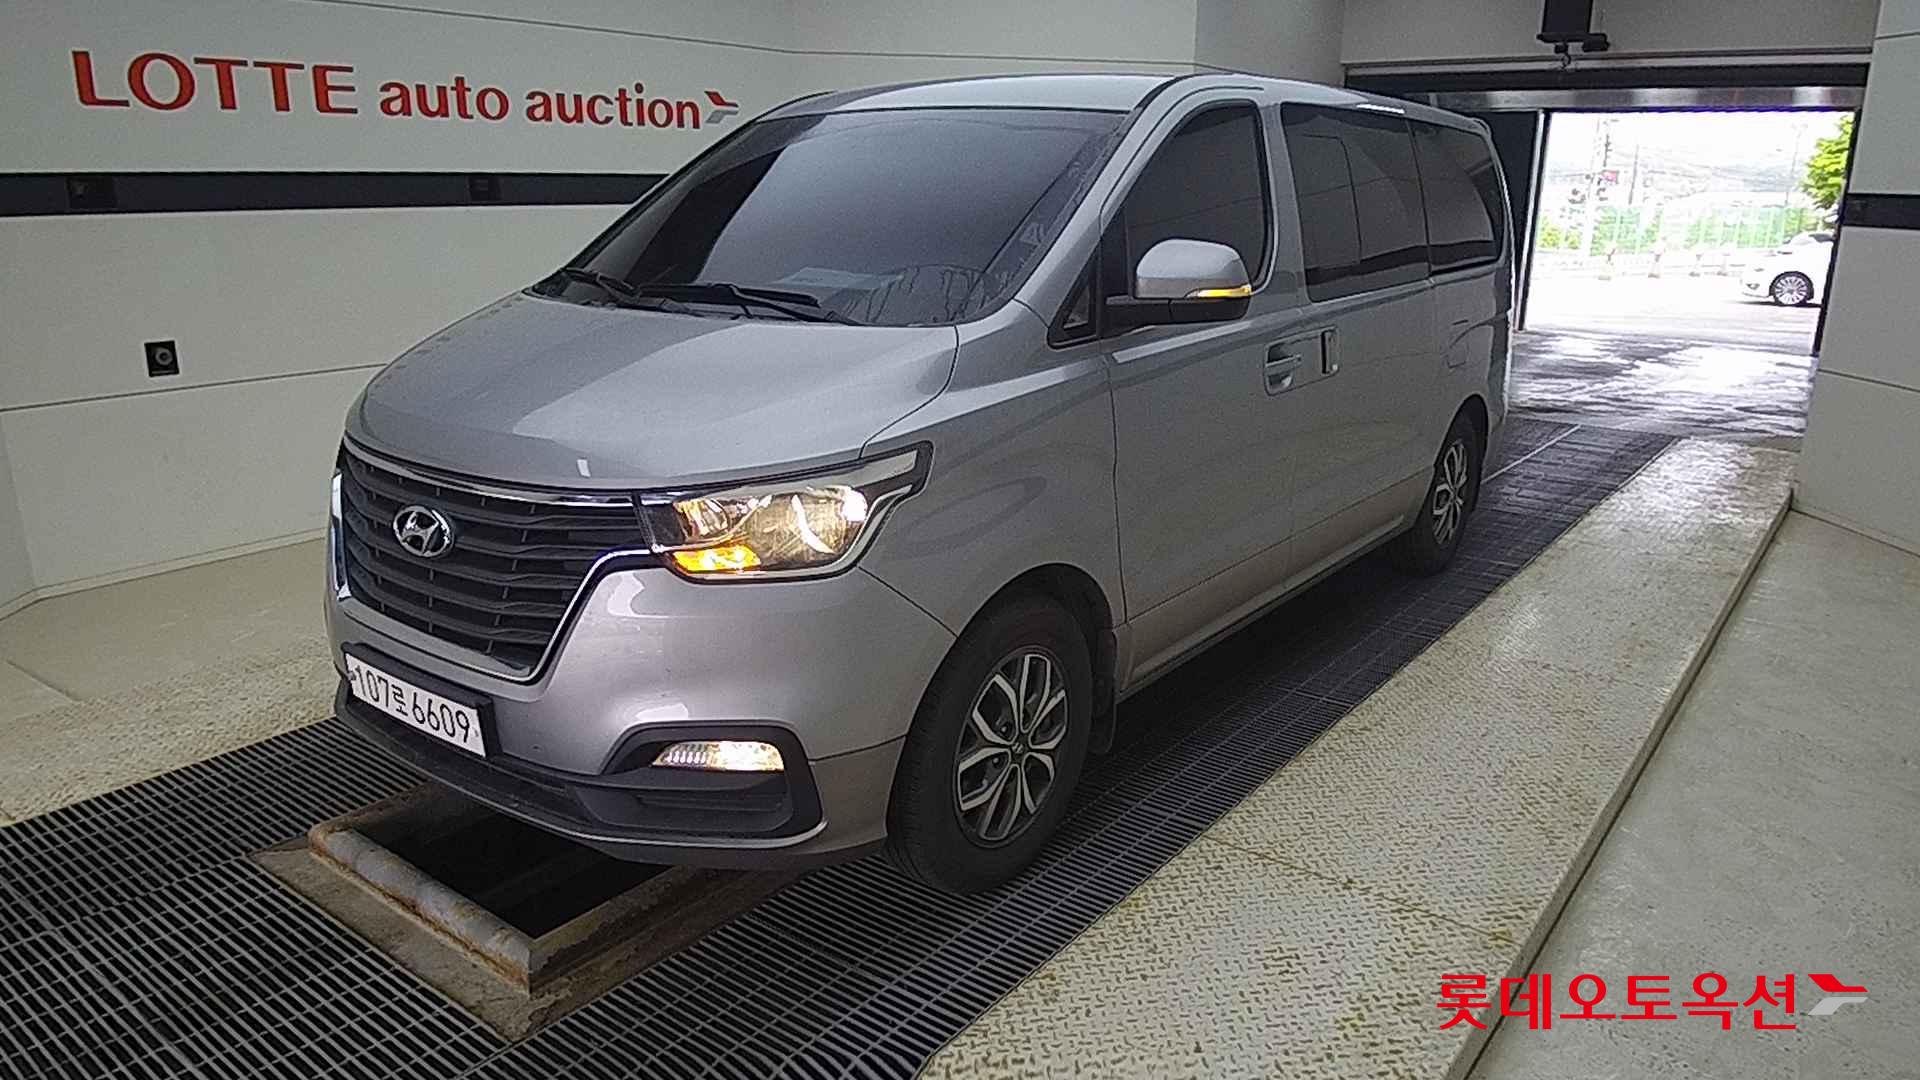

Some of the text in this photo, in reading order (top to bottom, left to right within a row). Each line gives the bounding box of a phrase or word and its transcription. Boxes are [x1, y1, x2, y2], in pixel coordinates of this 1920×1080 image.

[72, 50, 701, 129] LOTTE auto auction
